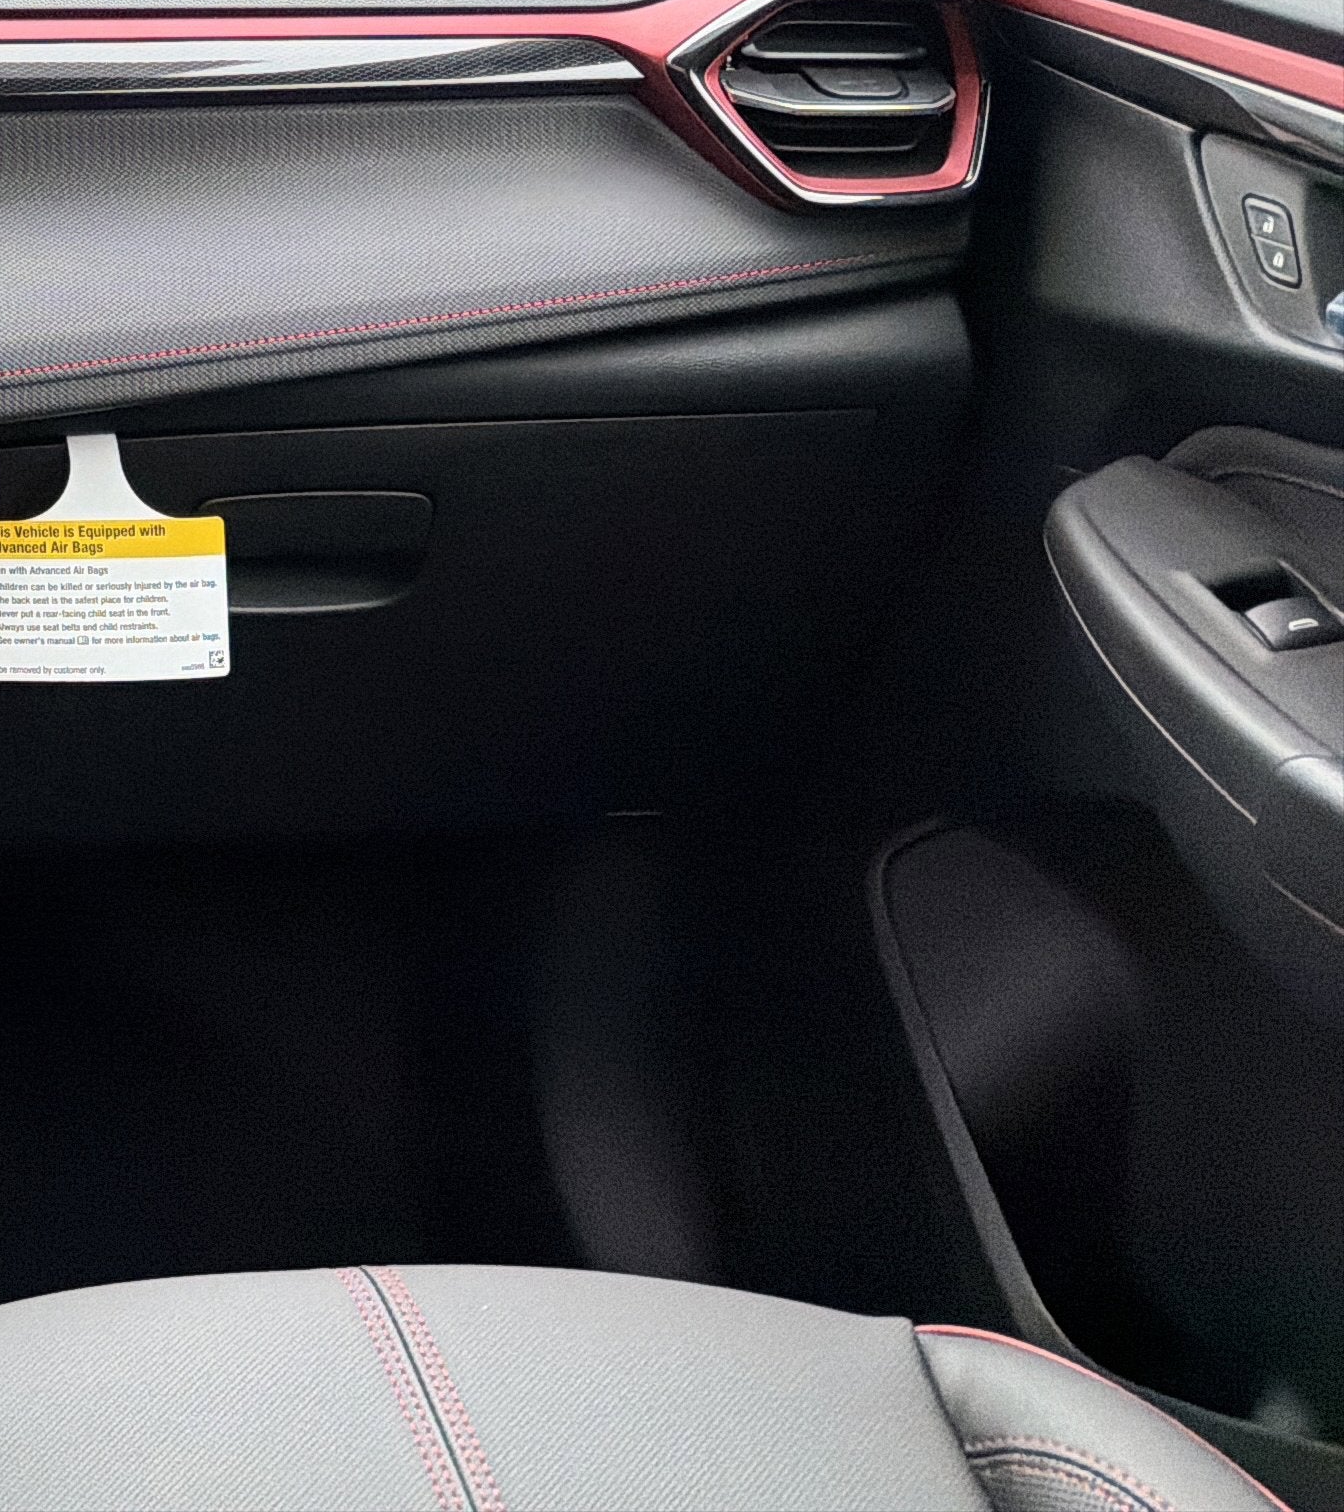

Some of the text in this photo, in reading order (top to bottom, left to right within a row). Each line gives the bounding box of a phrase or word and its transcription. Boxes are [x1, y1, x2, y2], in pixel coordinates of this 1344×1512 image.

[14, 526, 60, 538] Vehicle
[78, 525, 135, 539] Equipped
[139, 525, 165, 537] with
[50, 541, 69, 553] Air
[72, 541, 104, 555] Bags
[8, 566, 27, 575] with
[29, 566, 71, 575] Advanced
[73, 566, 84, 575] Air
[87, 566, 108, 576] Bags
[48, 582, 58, 590] be
[61, 582, 83, 590] killed
[96, 581, 132, 592] seriously
[134, 581, 161, 591] injured
[164, 580, 173, 591] by
[175, 580, 187, 589] the
[201, 580, 217, 590] bag.
[12, 596, 30, 604] back
[33, 596, 49, 604] seat
[52, 596, 58, 604] is
[61, 595, 72, 604] the
[100, 595, 121, 606] place
[124, 595, 134, 603] for
[136, 594, 168, 603] children.
[21, 610, 34, 619] put
[43, 609, 86, 619] rear-facing
[88, 609, 106, 617] child
[109, 609, 125, 617] seat
[127, 609, 134, 617] in
[136, 608, 148, 617] the
[151, 608, 170, 616] front.
[43, 623, 59, 631] seat
[62, 623, 80, 631] belts
[83, 623, 97, 631] and
[99, 622, 118, 630] child
[120, 622, 158, 630] restraints.
[14, 636, 45, 645] owner's
[47, 636, 75, 644] manual
[91, 636, 102, 645] for
[104, 637, 124, 645] more
[126, 635, 168, 644] information
[170, 635, 190, 643] about
[192, 634, 201, 643] air
[203, 634, 221, 644] bags.
[10, 665, 41, 674] removed
[43, 665, 52, 676] by
[54, 666, 87, 674] customer
[89, 665, 106, 676] only.
